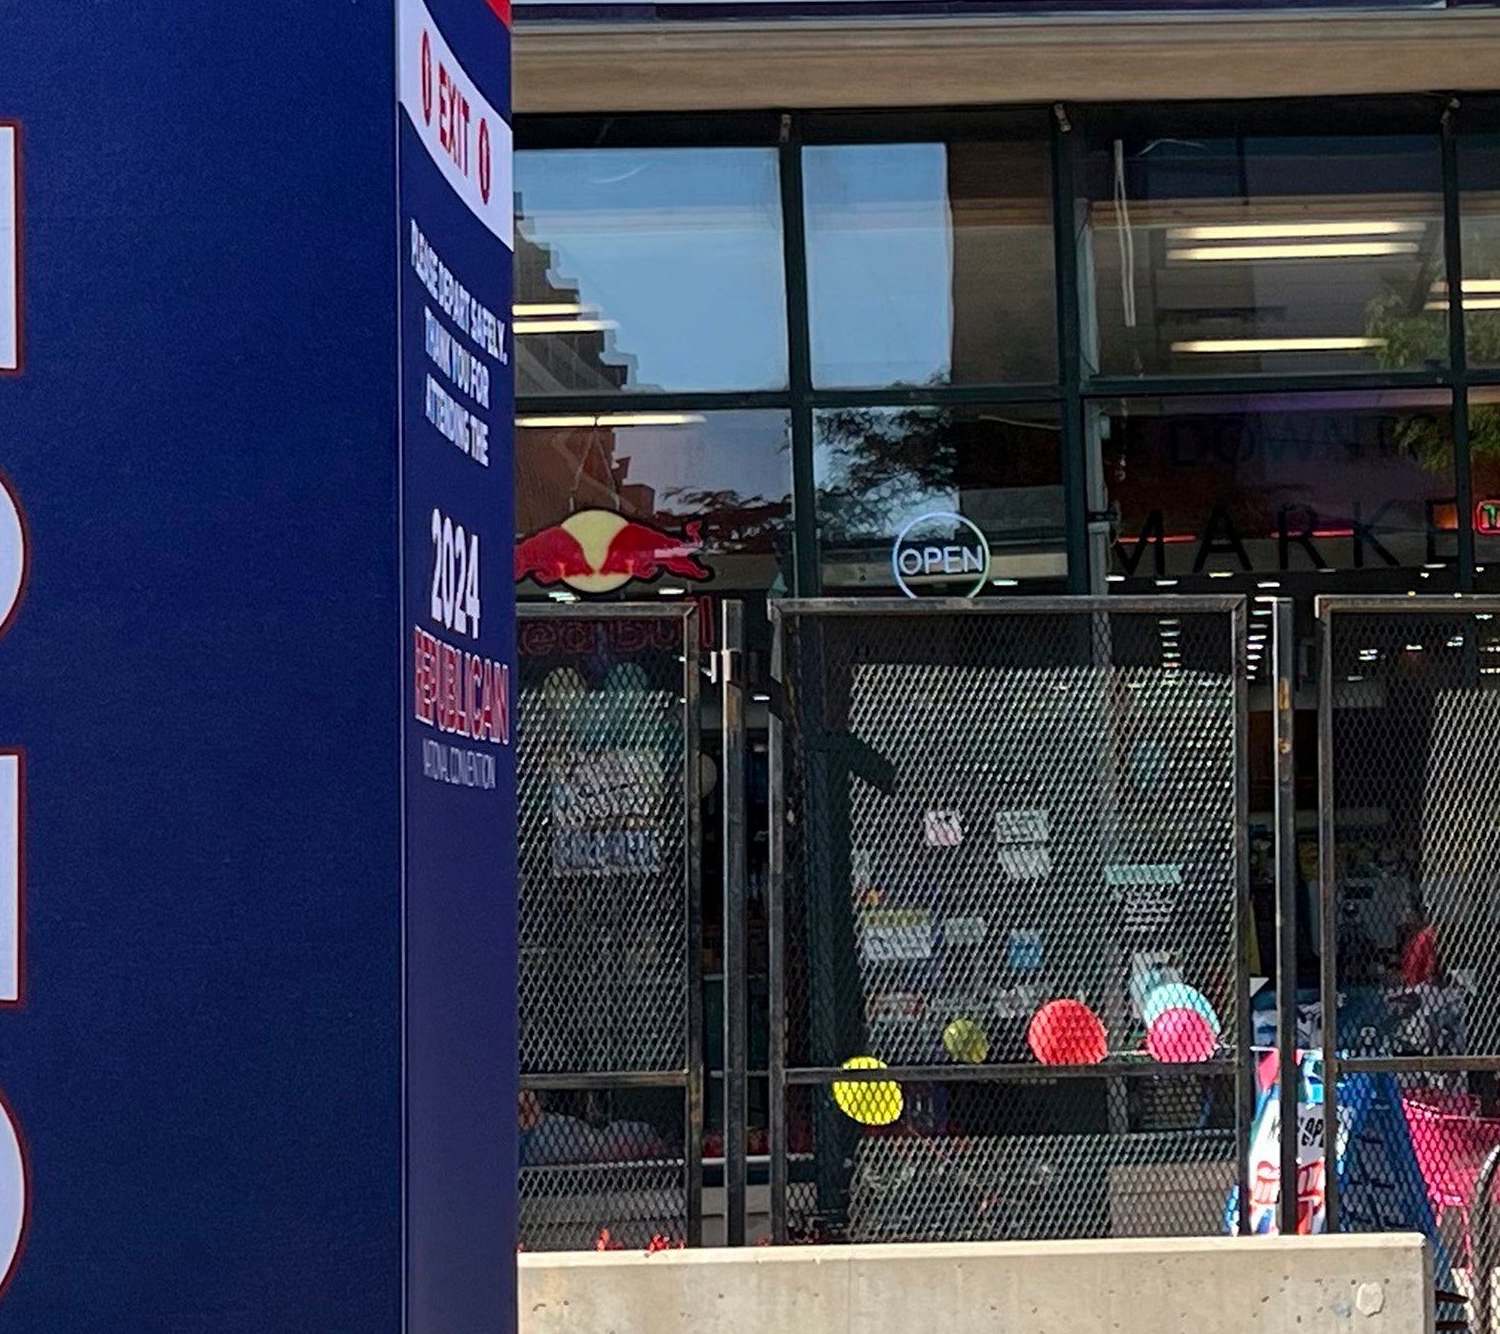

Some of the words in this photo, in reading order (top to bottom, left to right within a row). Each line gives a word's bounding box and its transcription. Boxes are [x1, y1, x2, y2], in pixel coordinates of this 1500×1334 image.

[437, 57, 471, 178] EXIT
[430, 507, 481, 641] 2024
[899, 544, 985, 577] OPEN
[413, 623, 510, 746] REPUBLICAN
